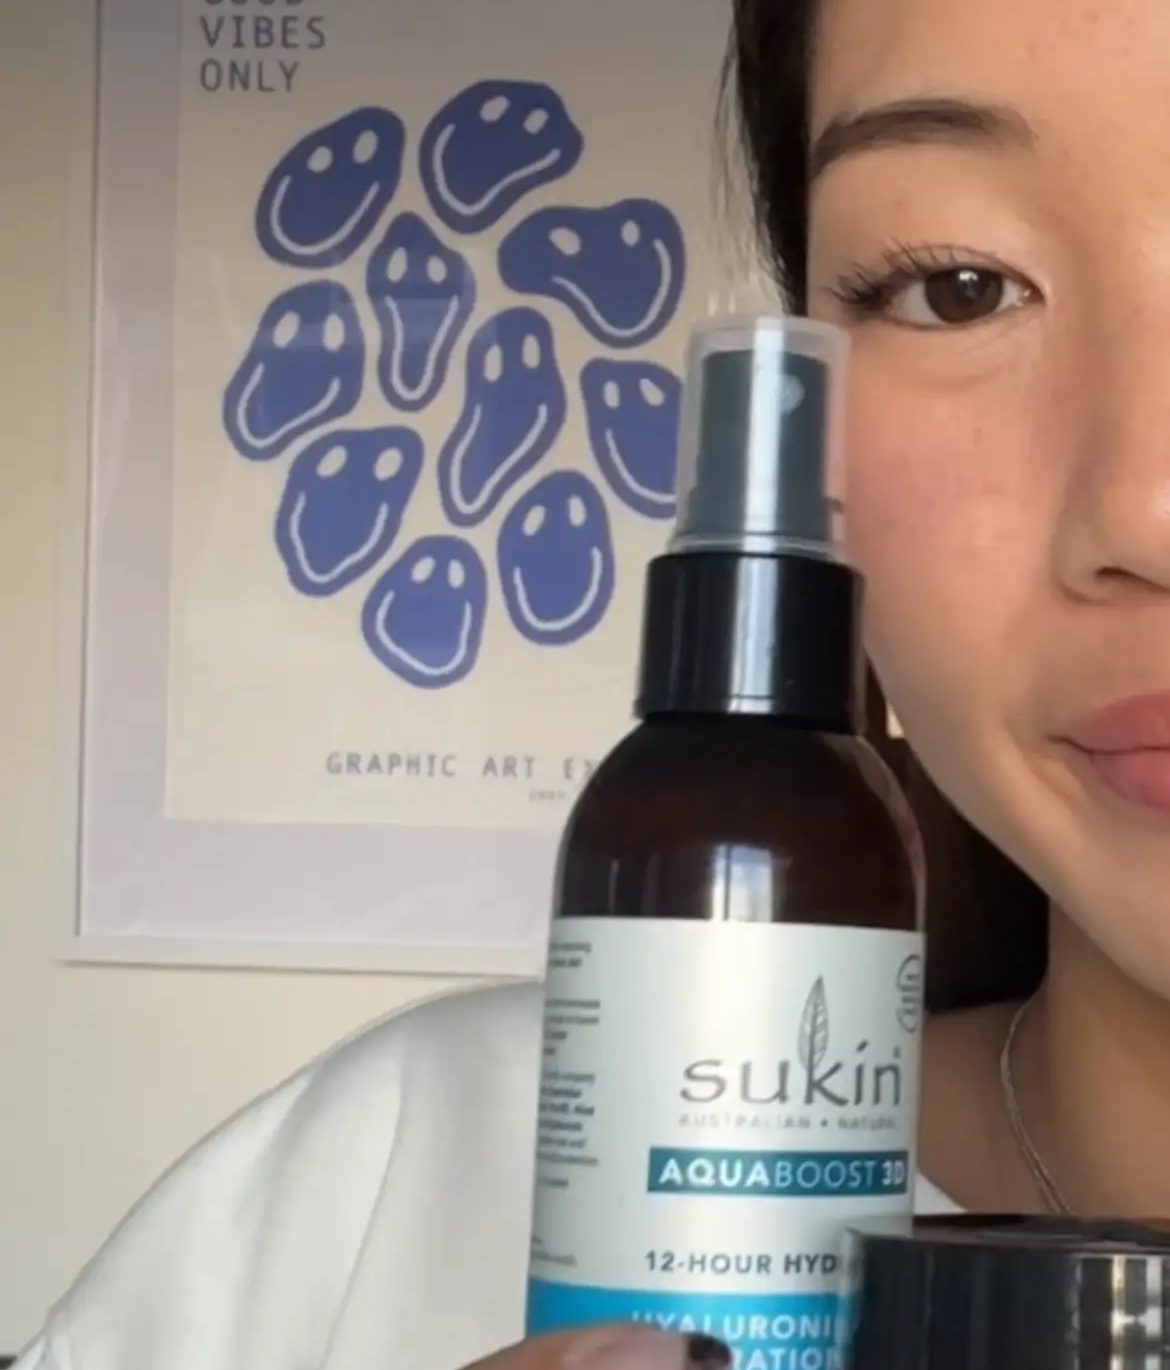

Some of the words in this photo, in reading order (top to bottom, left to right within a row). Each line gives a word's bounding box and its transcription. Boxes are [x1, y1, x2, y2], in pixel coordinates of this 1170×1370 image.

[198, 15, 326, 50] VIBES
[199, 58, 300, 93] ONLY
[325, 752, 457, 777] GRAPHIC
[482, 755, 536, 779] ART
[679, 1027, 902, 1107] sukin
[658, 1157, 876, 1188] AQUABOOST
[881, 1158, 906, 1187] 3D
[645, 1250, 773, 1275] 12-HOUR
